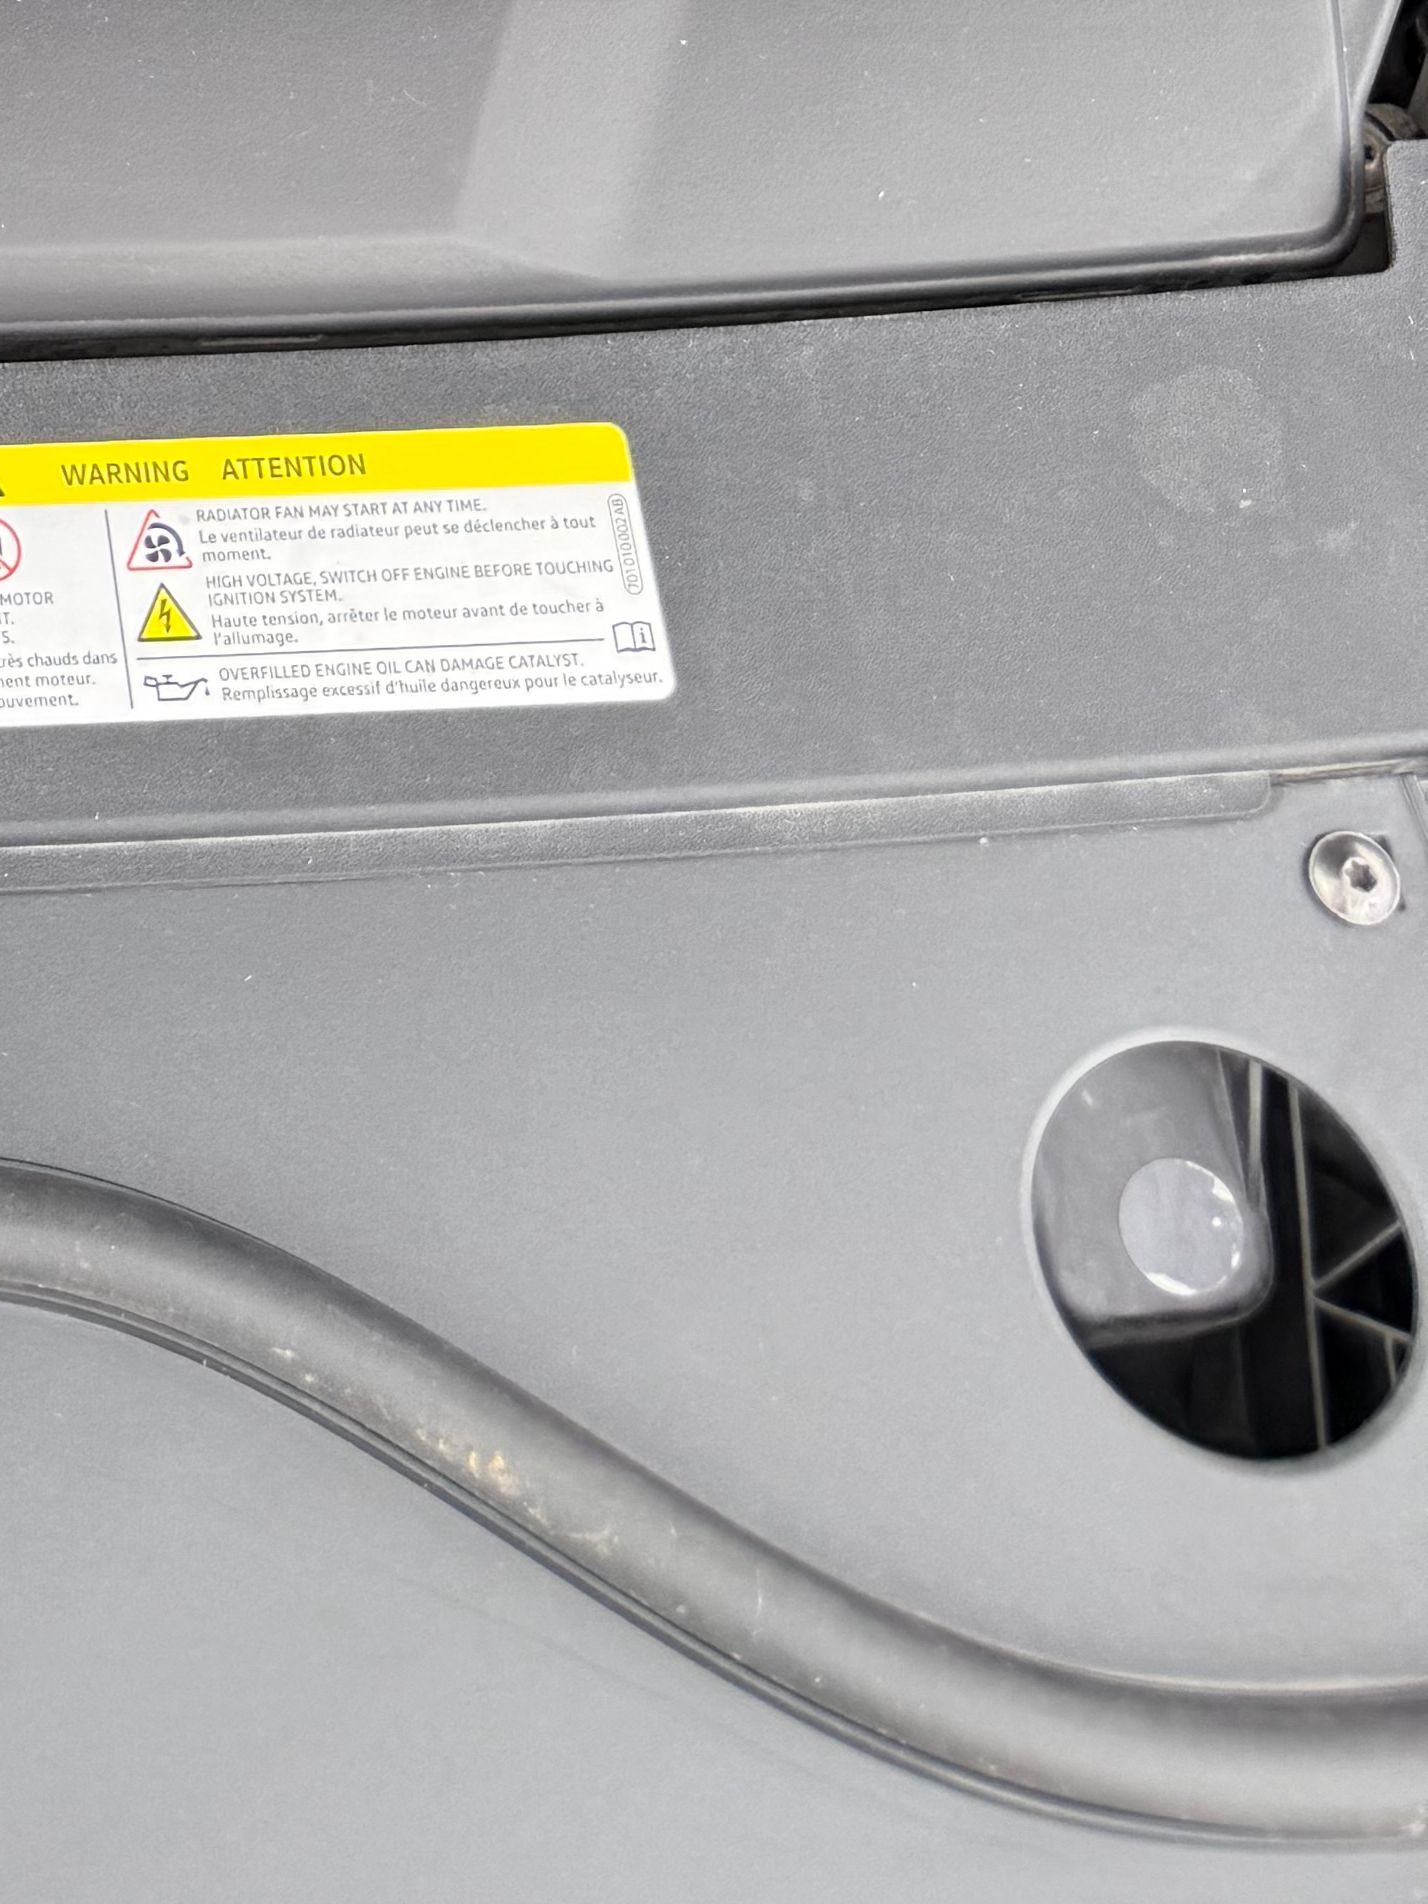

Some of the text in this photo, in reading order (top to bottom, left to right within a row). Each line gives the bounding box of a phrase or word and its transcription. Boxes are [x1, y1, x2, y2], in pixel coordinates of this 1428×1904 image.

[61, 452, 368, 487] WARNING ATTENTION
[196, 499, 487, 523] RADIATOR FAN MAY START AT ANY TIME.
[199, 515, 596, 544] Le ventilateur de radiateur peut se déclencher tout
[202, 548, 271, 562] moment.
[206, 560, 614, 589] HIGH VOLTAGE, SWITCH OFF ENGINE BEFORE TOUCHING
[0, 591, 54, 606] MOTOR
[208, 589, 343, 607] IGNITION SYSTEM.
[211, 599, 591, 628] Haute tension, arrêter moteur avant de toucher
[213, 631, 299, 647] l'allumage.
[28, 652, 79, 667] chauds
[83, 651, 118, 665] dans
[219, 653, 584, 682] OVERFILLED ENGINE OIL CAN DAMAGE CATALYST.
[36, 673, 96, 687] moteur.
[222, 669, 664, 703] Remplissage excessif d'huile dangereux pour catalyseur.
